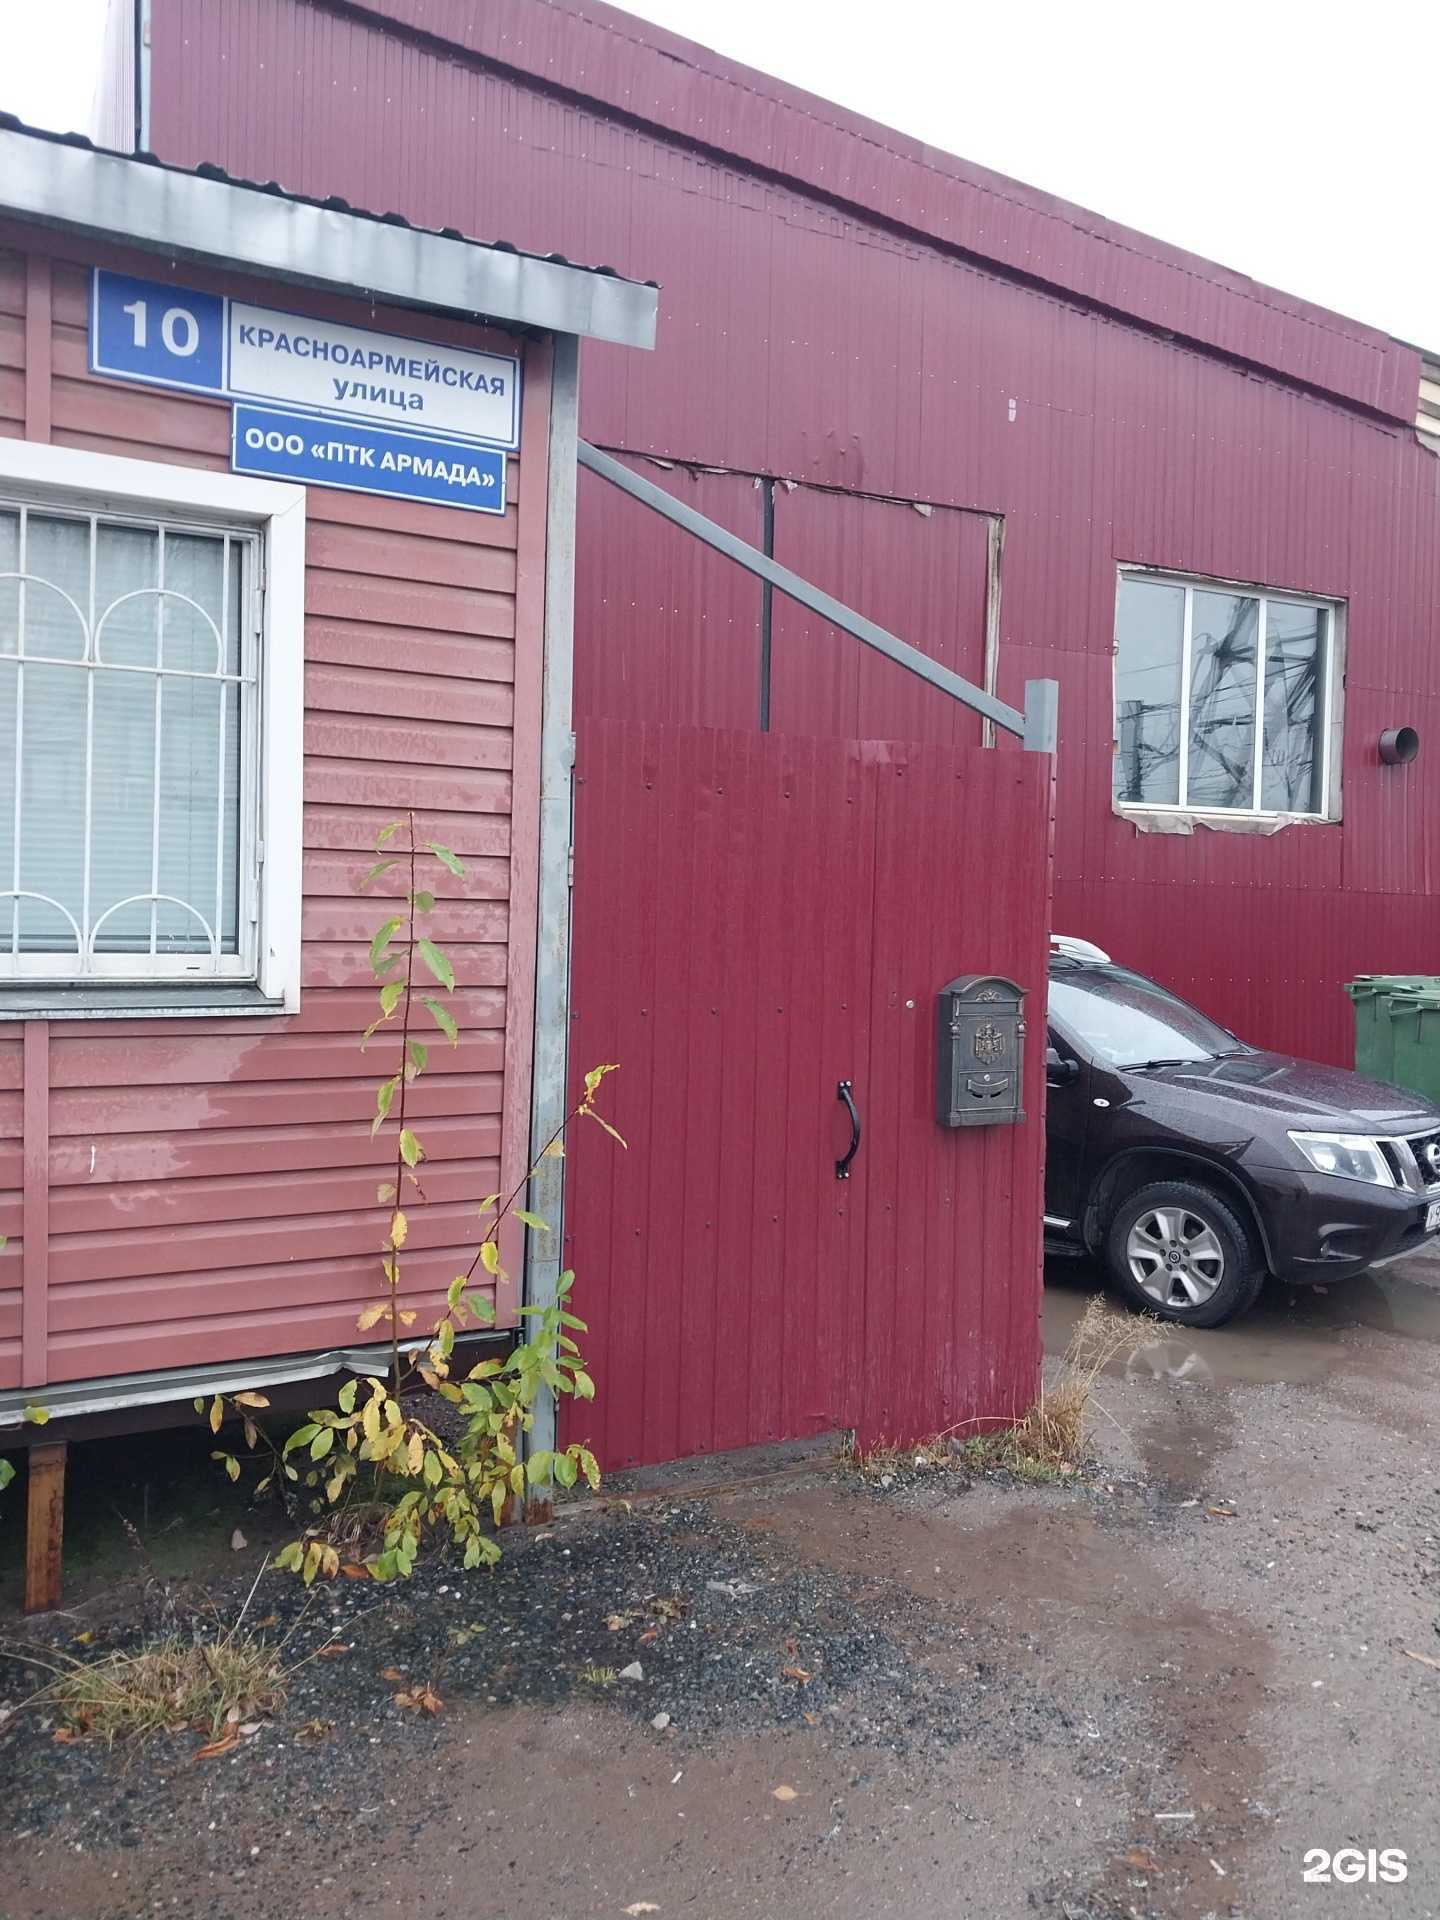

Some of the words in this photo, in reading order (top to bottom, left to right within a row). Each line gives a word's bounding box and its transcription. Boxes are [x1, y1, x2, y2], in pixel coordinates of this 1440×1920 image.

[123, 300, 199, 357] 10
[239, 324, 505, 396] КРАСНОАРМЕЙСКАЯ
[332, 378, 425, 411] улица
[245, 427, 304, 456] ООО
[311, 442, 375, 468] «ПТК
[380, 451, 495, 488] АРМАДА»
